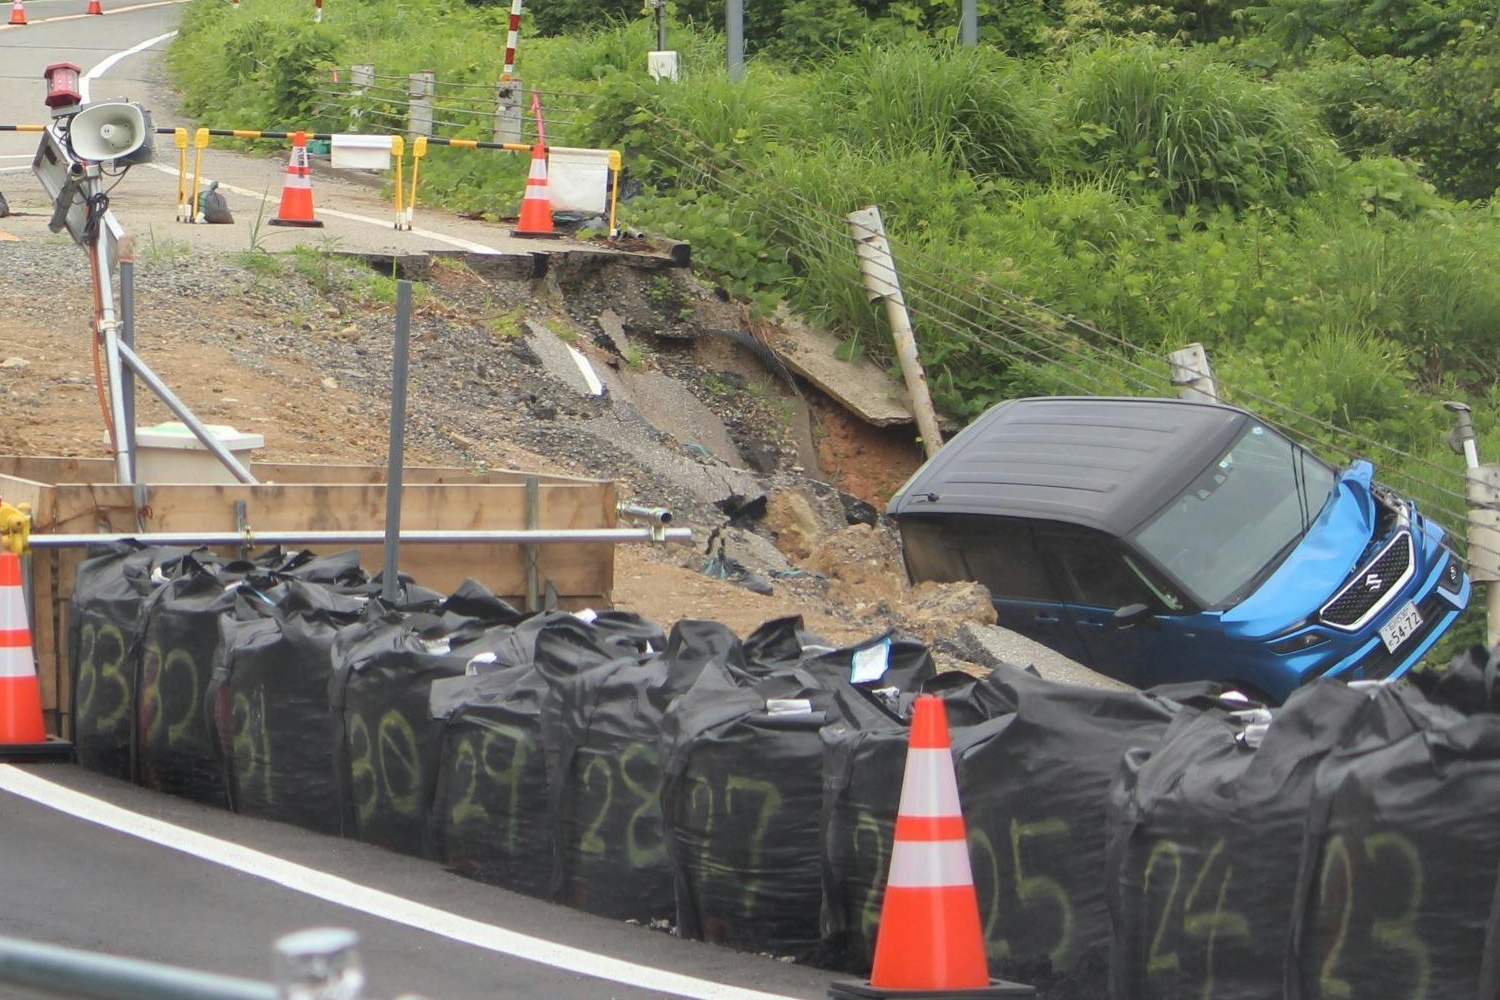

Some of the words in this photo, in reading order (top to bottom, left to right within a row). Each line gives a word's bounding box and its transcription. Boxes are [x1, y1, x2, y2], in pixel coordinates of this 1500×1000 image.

[77, 622, 131, 729] 33
[1391, 612, 1420, 644] 54-72
[451, 726, 534, 856] 29
[580, 743, 668, 869] 28
[1144, 837, 1250, 1000] 24
